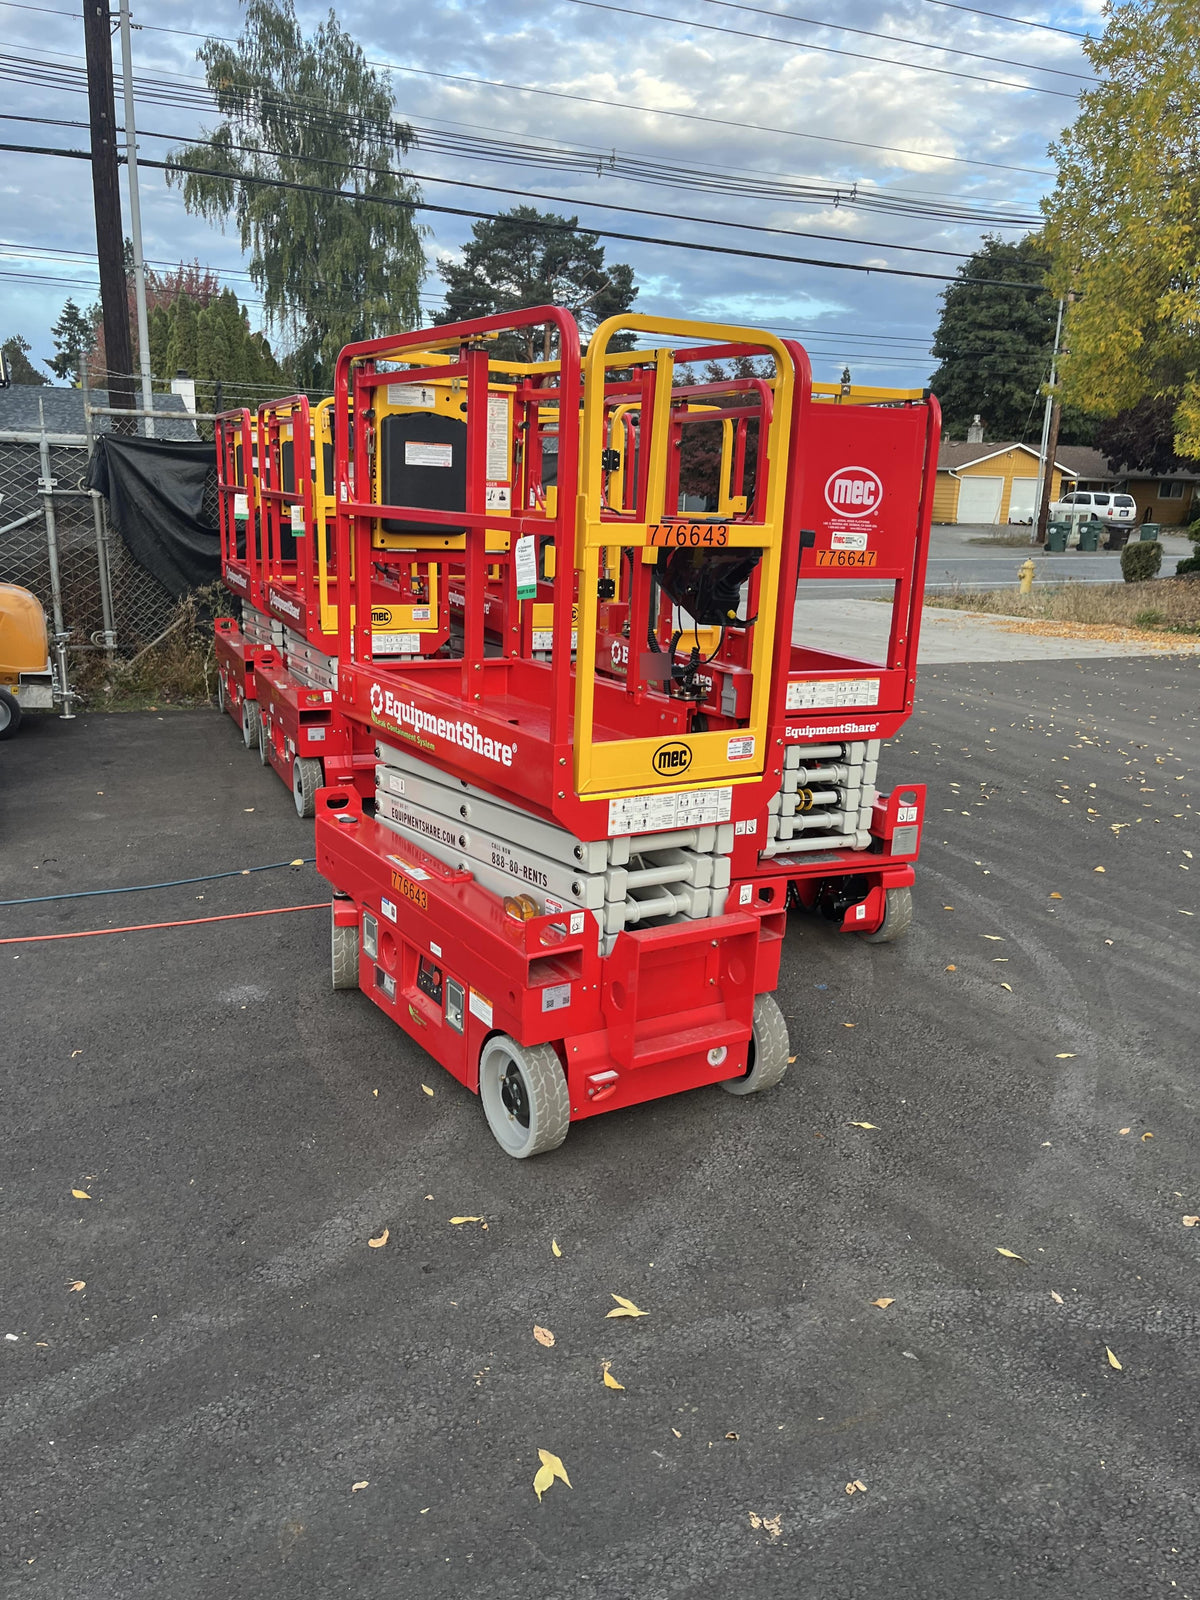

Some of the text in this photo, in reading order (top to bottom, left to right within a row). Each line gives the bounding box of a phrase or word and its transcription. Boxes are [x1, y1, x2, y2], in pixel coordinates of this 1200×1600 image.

[649, 525, 727, 546] 776643
[818, 550, 876, 566] 776647
[387, 722, 417, 742] Containment
[417, 736, 435, 750] System
[391, 807, 456, 846] EQUIPMENTSHARE.COM
[491, 842, 511, 855] CALL NOW
[491, 852, 548, 887] 888-80-RENTS
[392, 870, 427, 909] 776643
